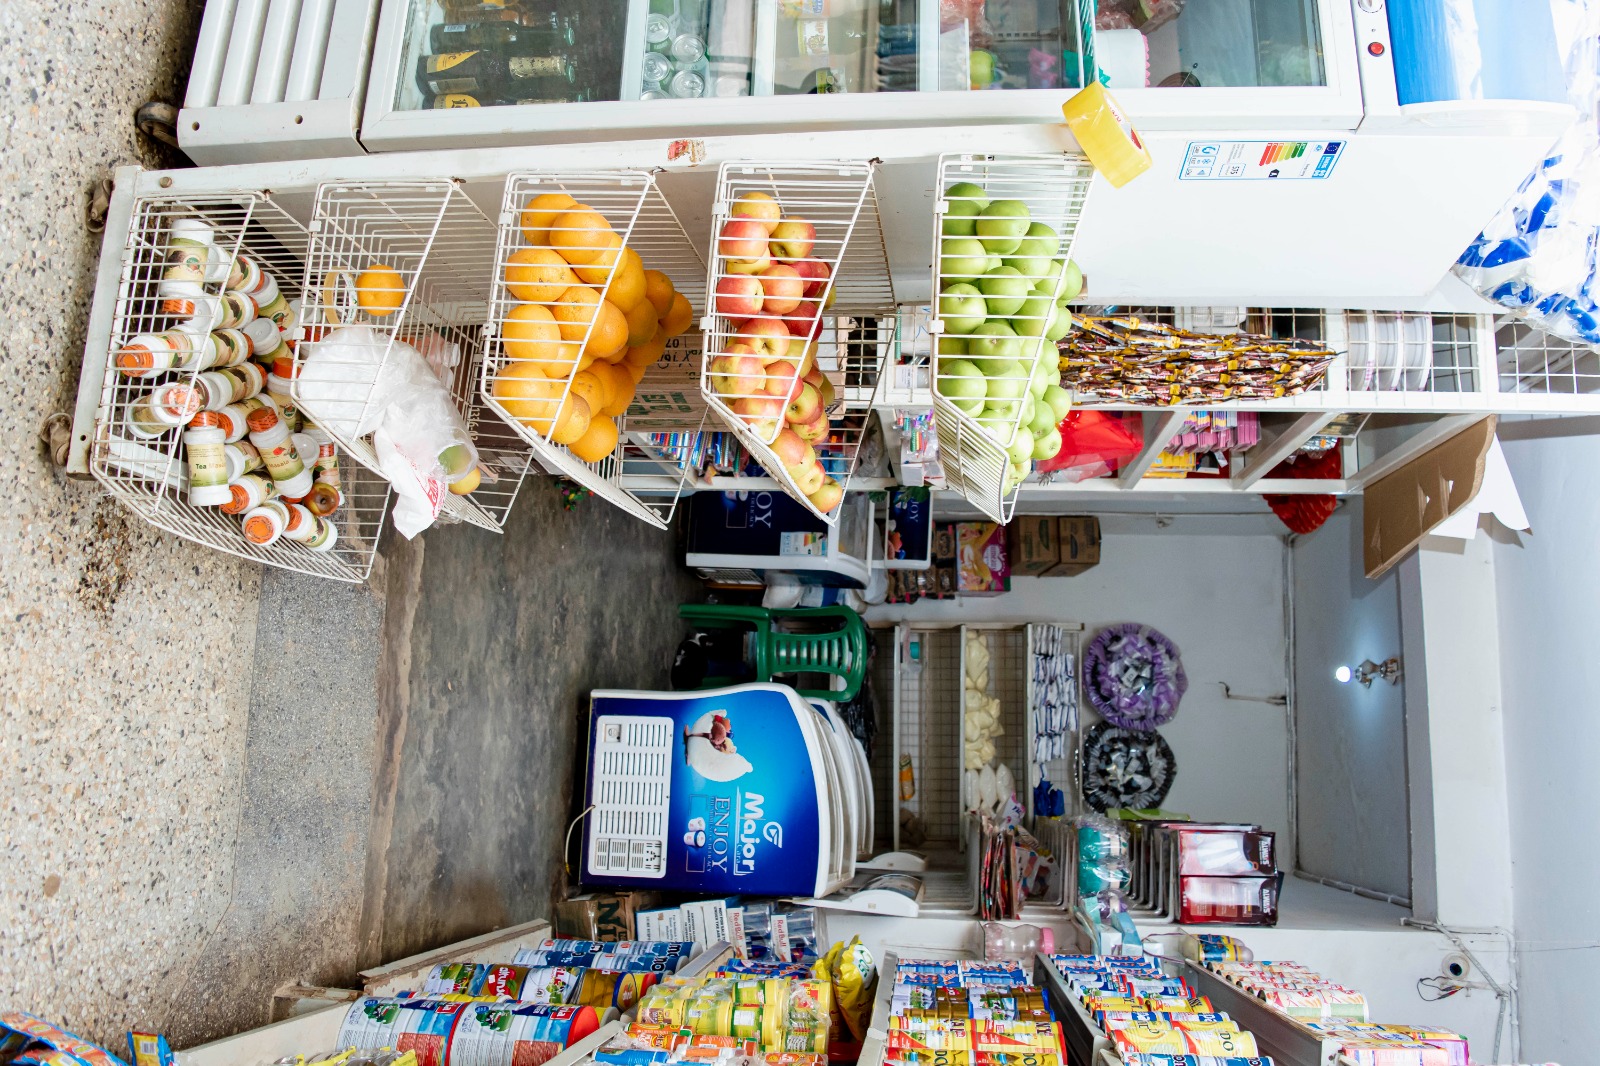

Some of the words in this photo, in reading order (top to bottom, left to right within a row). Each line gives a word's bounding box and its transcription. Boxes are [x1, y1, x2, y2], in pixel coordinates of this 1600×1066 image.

[666, 339, 680, 348] 07
[712, 797, 730, 873] ENJOY
[740, 792, 764, 870] Major
[733, 912, 741, 926] Red
[776, 920, 784, 933] Red
[1220, 1032, 1234, 1051] DO
[1022, 1053, 1038, 1066] DO
